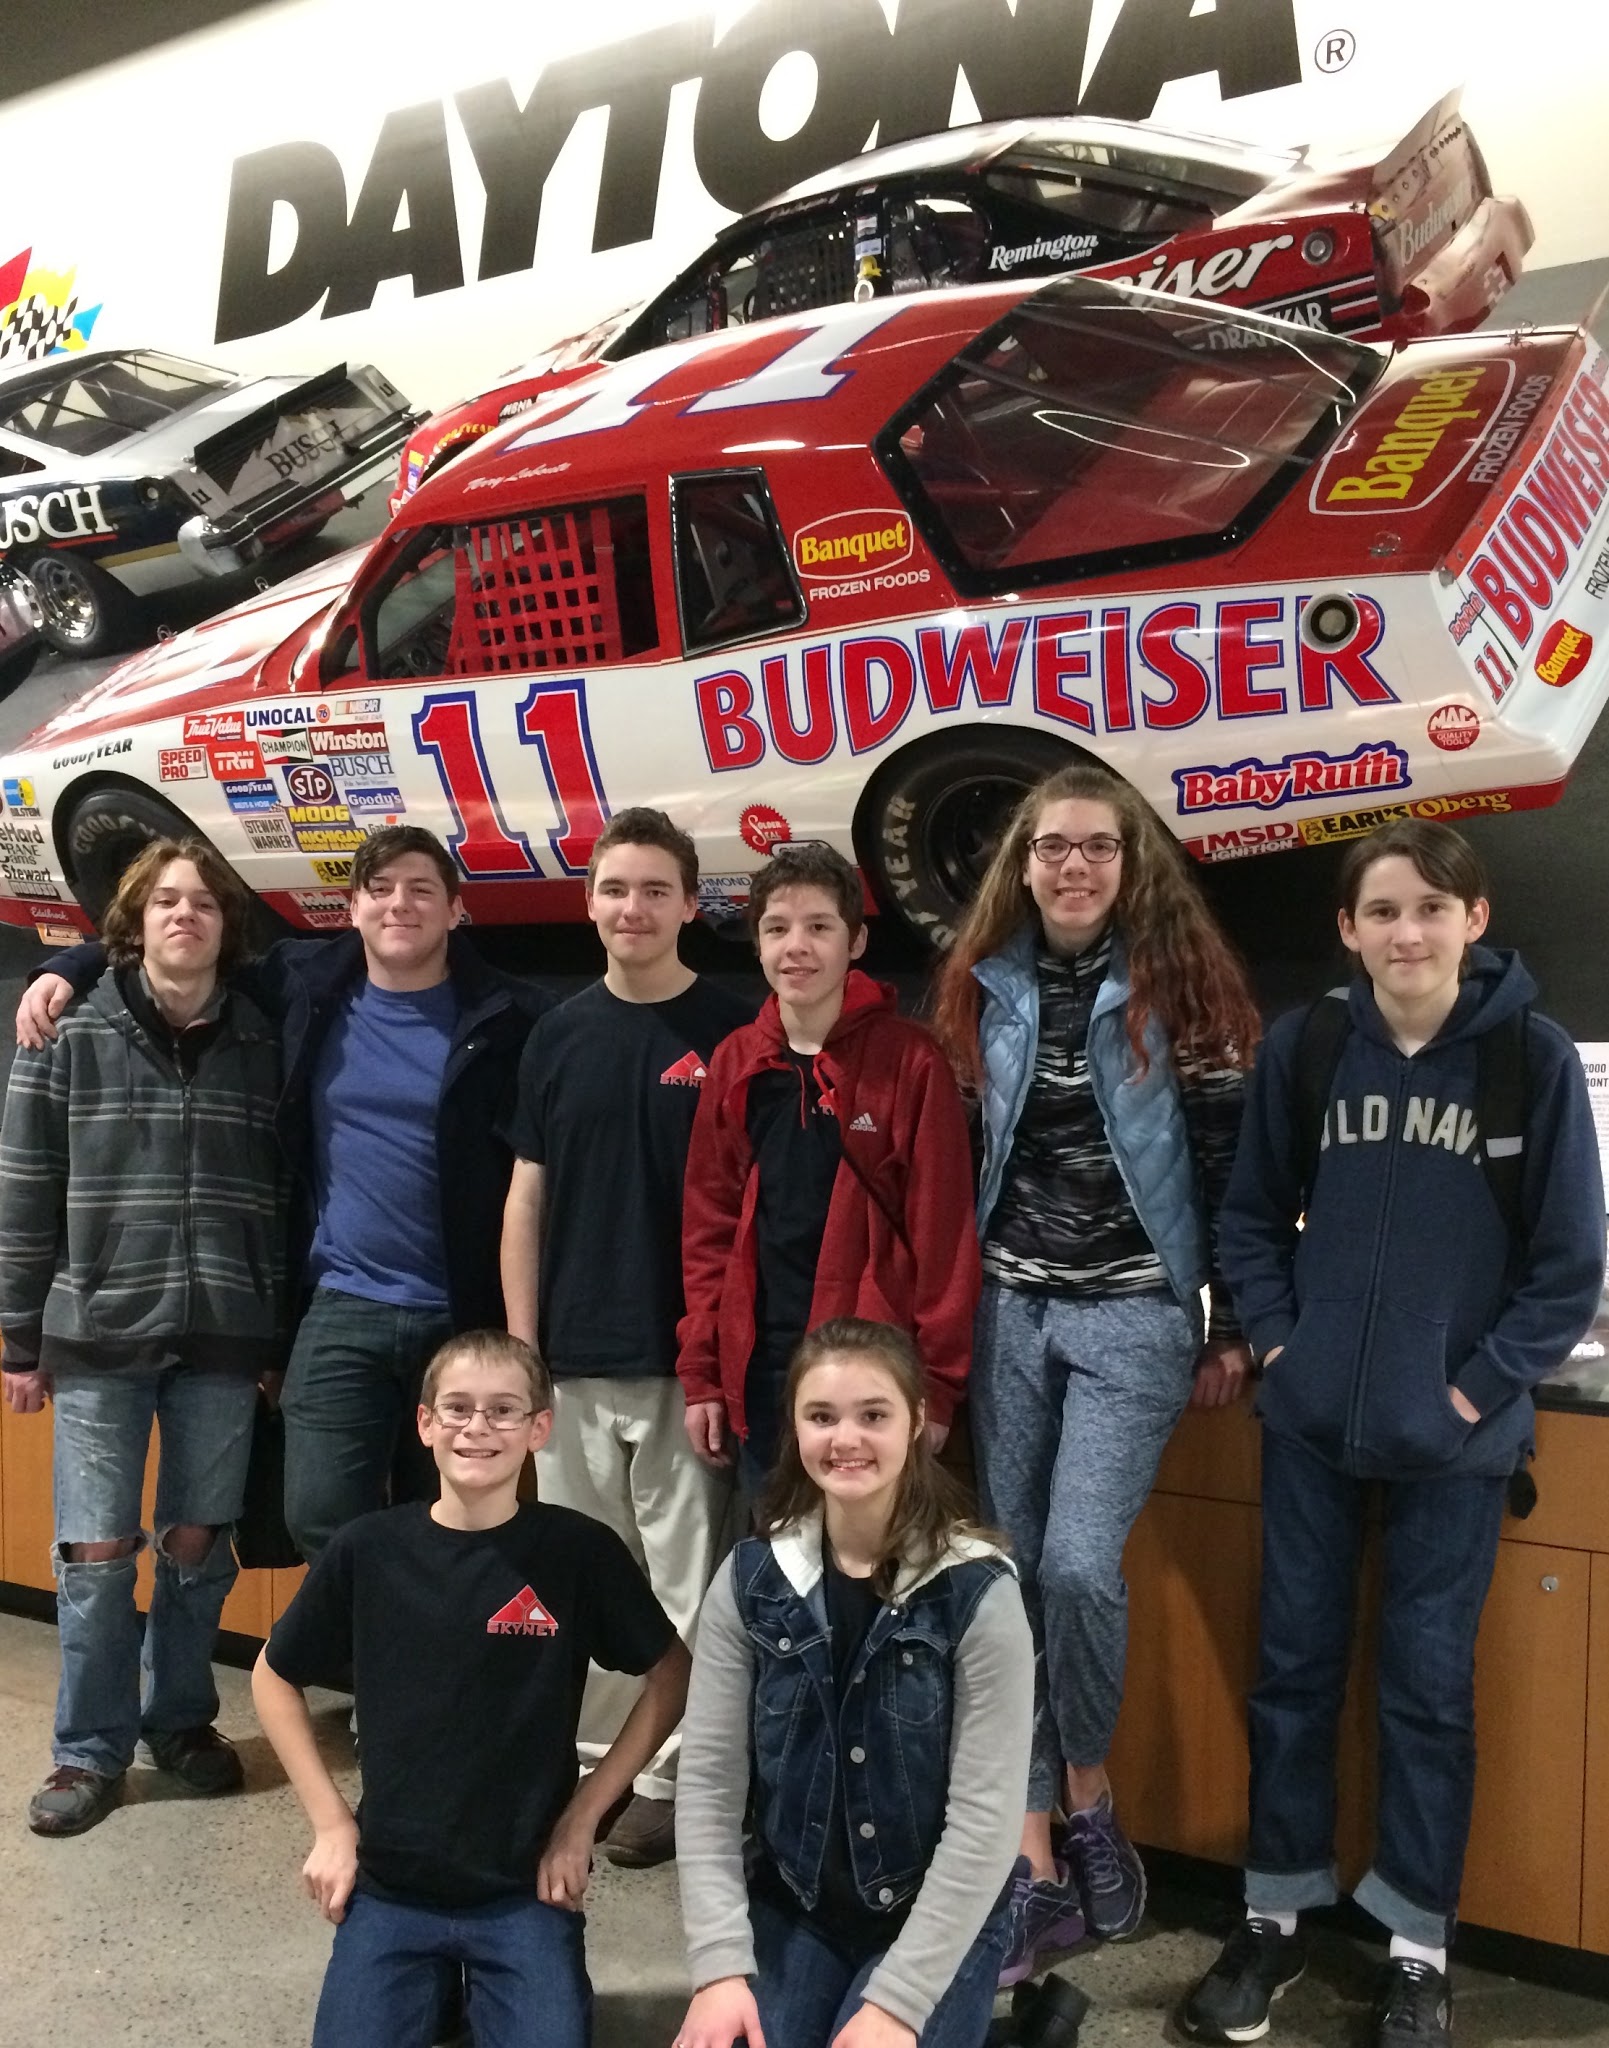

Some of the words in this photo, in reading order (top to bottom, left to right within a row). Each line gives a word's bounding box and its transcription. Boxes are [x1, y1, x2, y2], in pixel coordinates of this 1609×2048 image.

[214, 0, 1301, 343] DAYTONA
[989, 233, 1099, 271] Remington
[1063, 249, 1093, 262] ARMS
[1326, 366, 1487, 502] Banquet
[1467, 425, 1517, 484] FROZEN
[1511, 375, 1552, 427] FOODS
[0, 485, 114, 549] USCH
[1467, 371, 1609, 651] BUDWEISER
[801, 520, 907, 565] Banquet
[809, 580, 871, 602] FROZEN
[874, 569, 931, 591] FOODS
[1536, 625, 1586, 684] Banquet
[694, 593, 1402, 773] BUDWEISER
[1474, 642, 1514, 705] 11
[246, 707, 315, 727] UNOCAL
[318, 708, 329, 719] 76
[262, 739, 307, 753] CHAMPION
[310, 728, 387, 752] Winston
[1436, 730, 1473, 741] QUALITY
[1441, 737, 1471, 746] TOOLS
[161, 751, 200, 765] SPEED
[214, 751, 254, 771] TRW
[329, 755, 395, 777] BUSCH
[162, 764, 189, 778] PRO
[411, 679, 612, 881] 11
[1183, 768, 1291, 805] Baby
[1292, 747, 1402, 795] Ruth
[294, 770, 327, 797] STP
[348, 792, 402, 807] Goody's
[1416, 791, 1510, 817] Oberg
[288, 805, 349, 823] MOOG
[1322, 805, 1410, 840] EARL'S
[245, 819, 286, 834] STEWART
[296, 829, 367, 844] MICHIGAN
[1208, 822, 1295, 852] MSD
[252, 836, 294, 850] WARNER
[1211, 839, 1293, 862] IGNITION
[2, 864, 52, 882] Stewart
[697, 876, 751, 888] HMOND
[850, 1123, 877, 1133] adidas
[1321, 1095, 1388, 1151] LD
[1403, 1096, 1481, 1165] NAV
[487, 1622, 558, 1637] SKYNET
